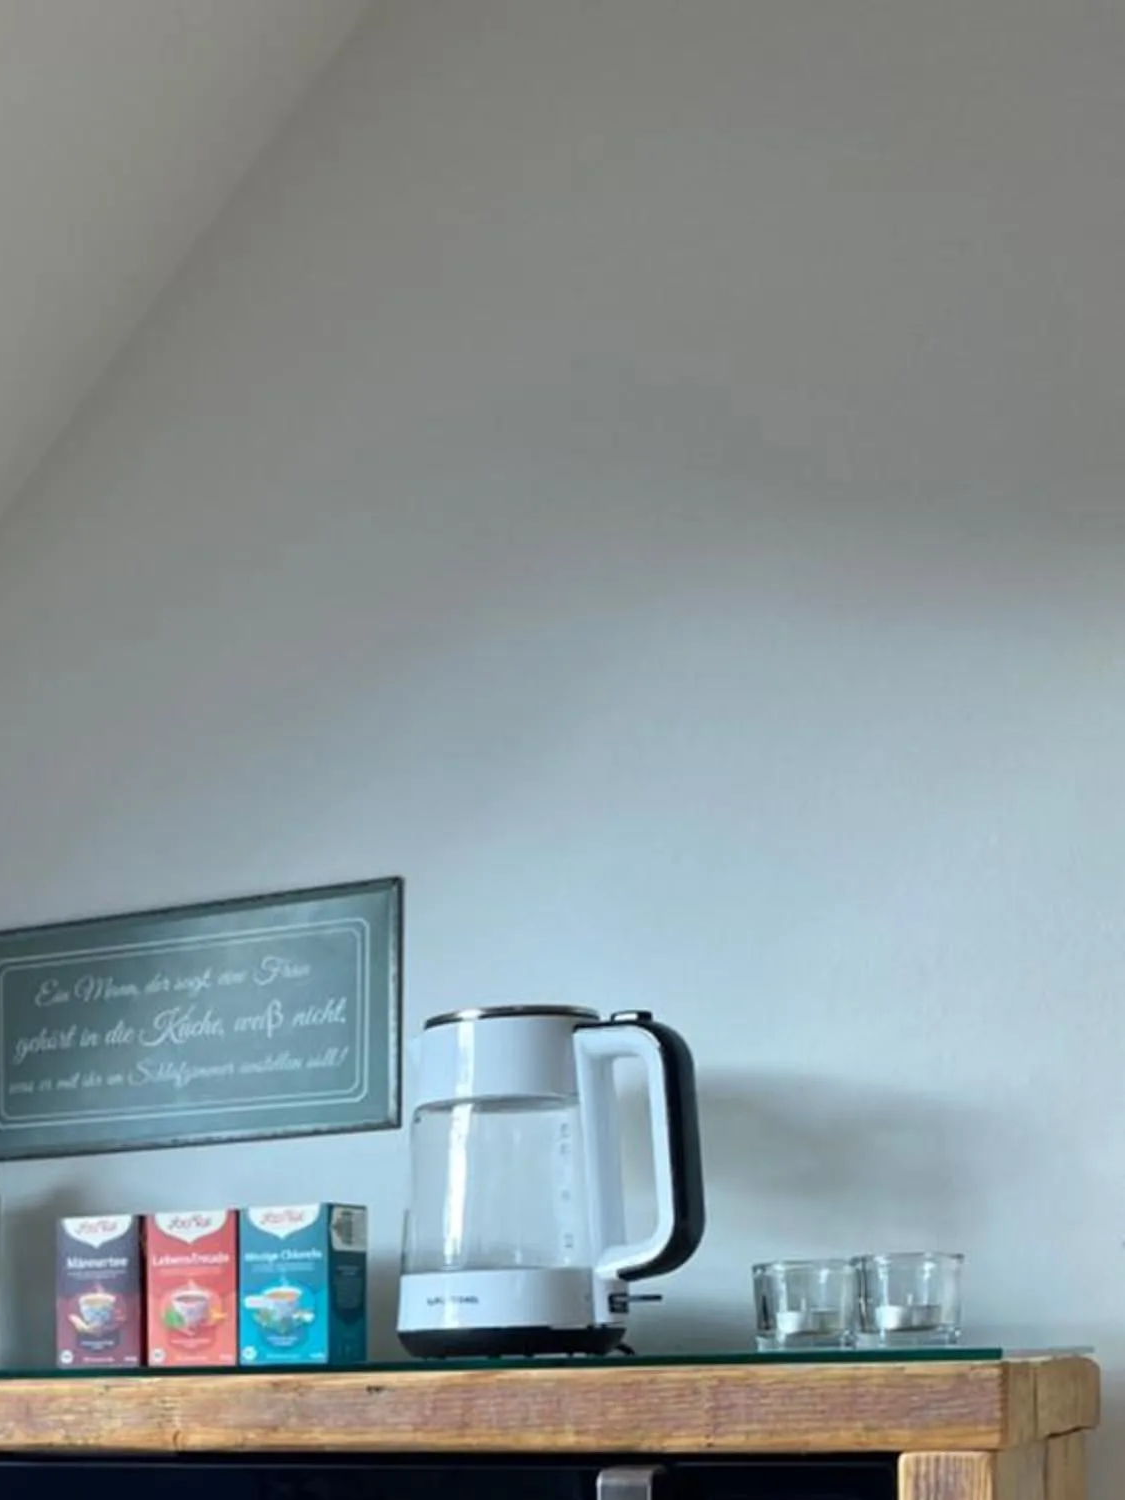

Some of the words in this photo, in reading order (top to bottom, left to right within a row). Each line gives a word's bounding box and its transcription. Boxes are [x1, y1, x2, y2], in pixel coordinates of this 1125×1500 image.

[79, 1027, 100, 1047] in
[104, 1019, 135, 1045] die
[234, 998, 284, 1039] weiß
